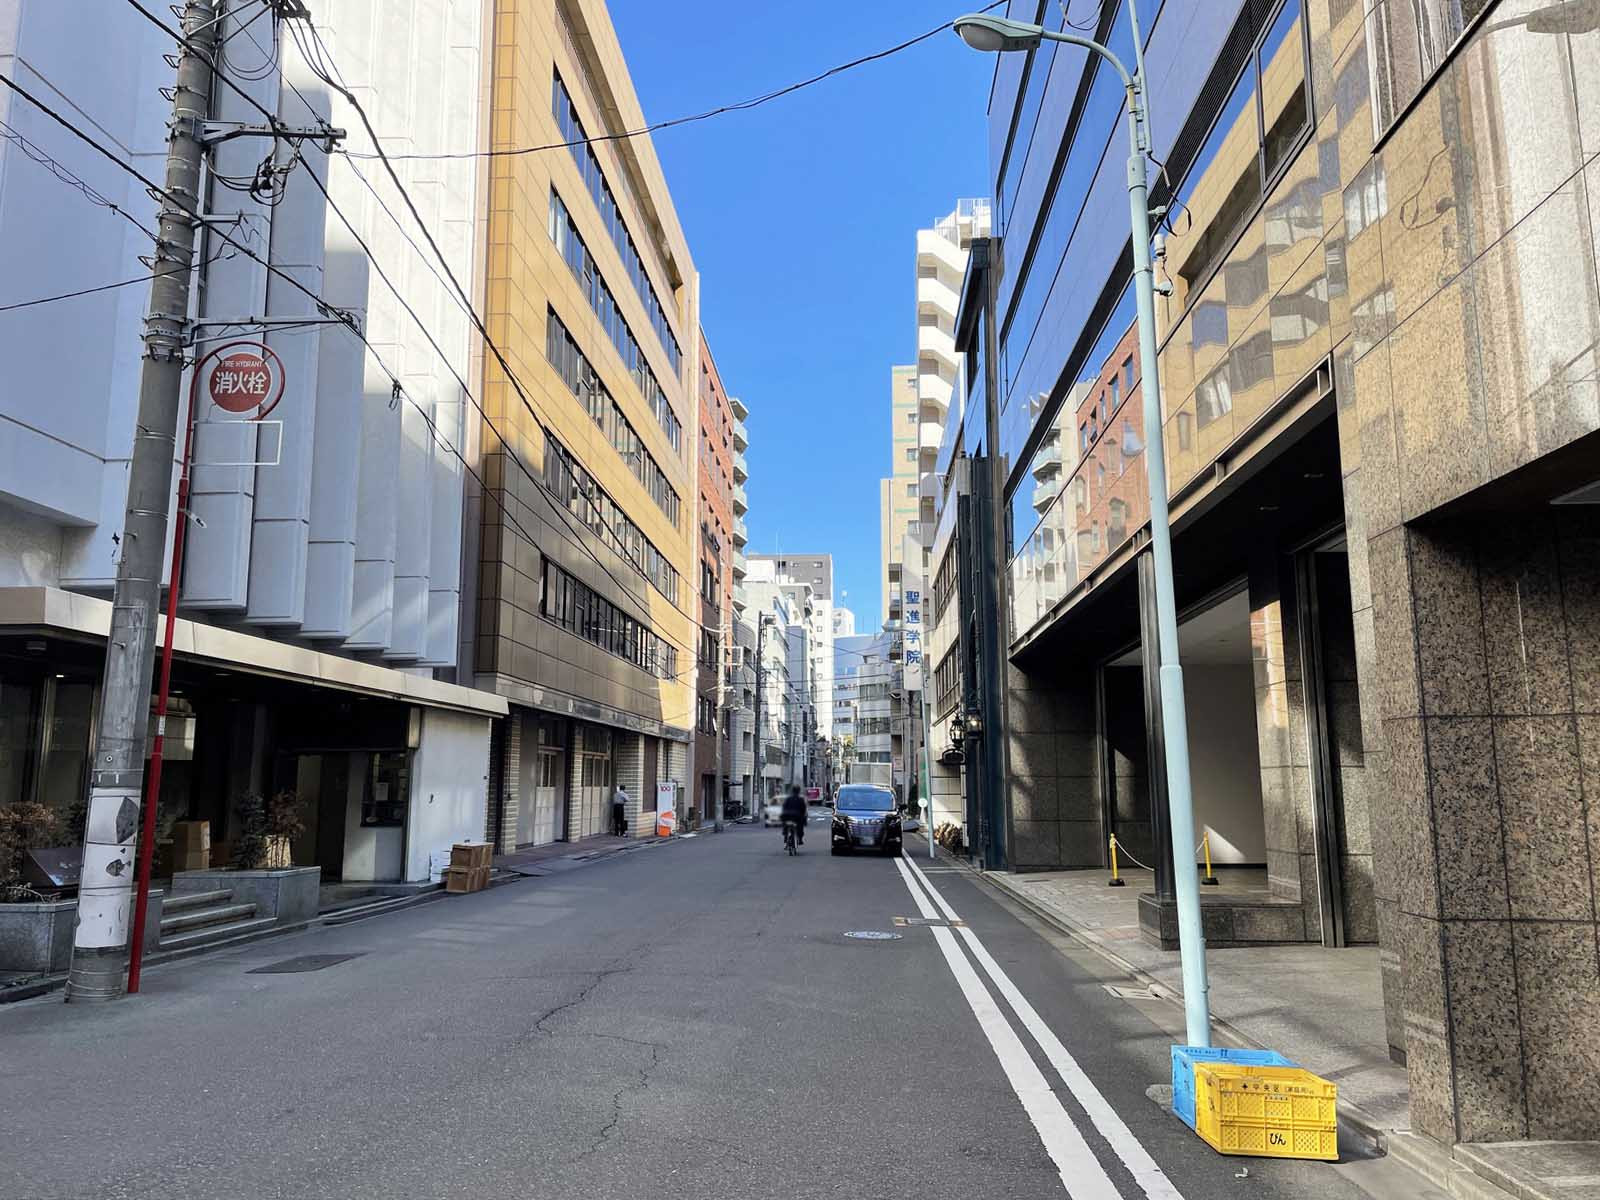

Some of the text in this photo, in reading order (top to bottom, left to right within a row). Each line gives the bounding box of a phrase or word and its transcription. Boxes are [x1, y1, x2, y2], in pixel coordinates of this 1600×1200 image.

[214, 371, 267, 394] 消火栓
[905, 590, 921, 666] 聖進学院
[1269, 1133, 1287, 1146] びん
